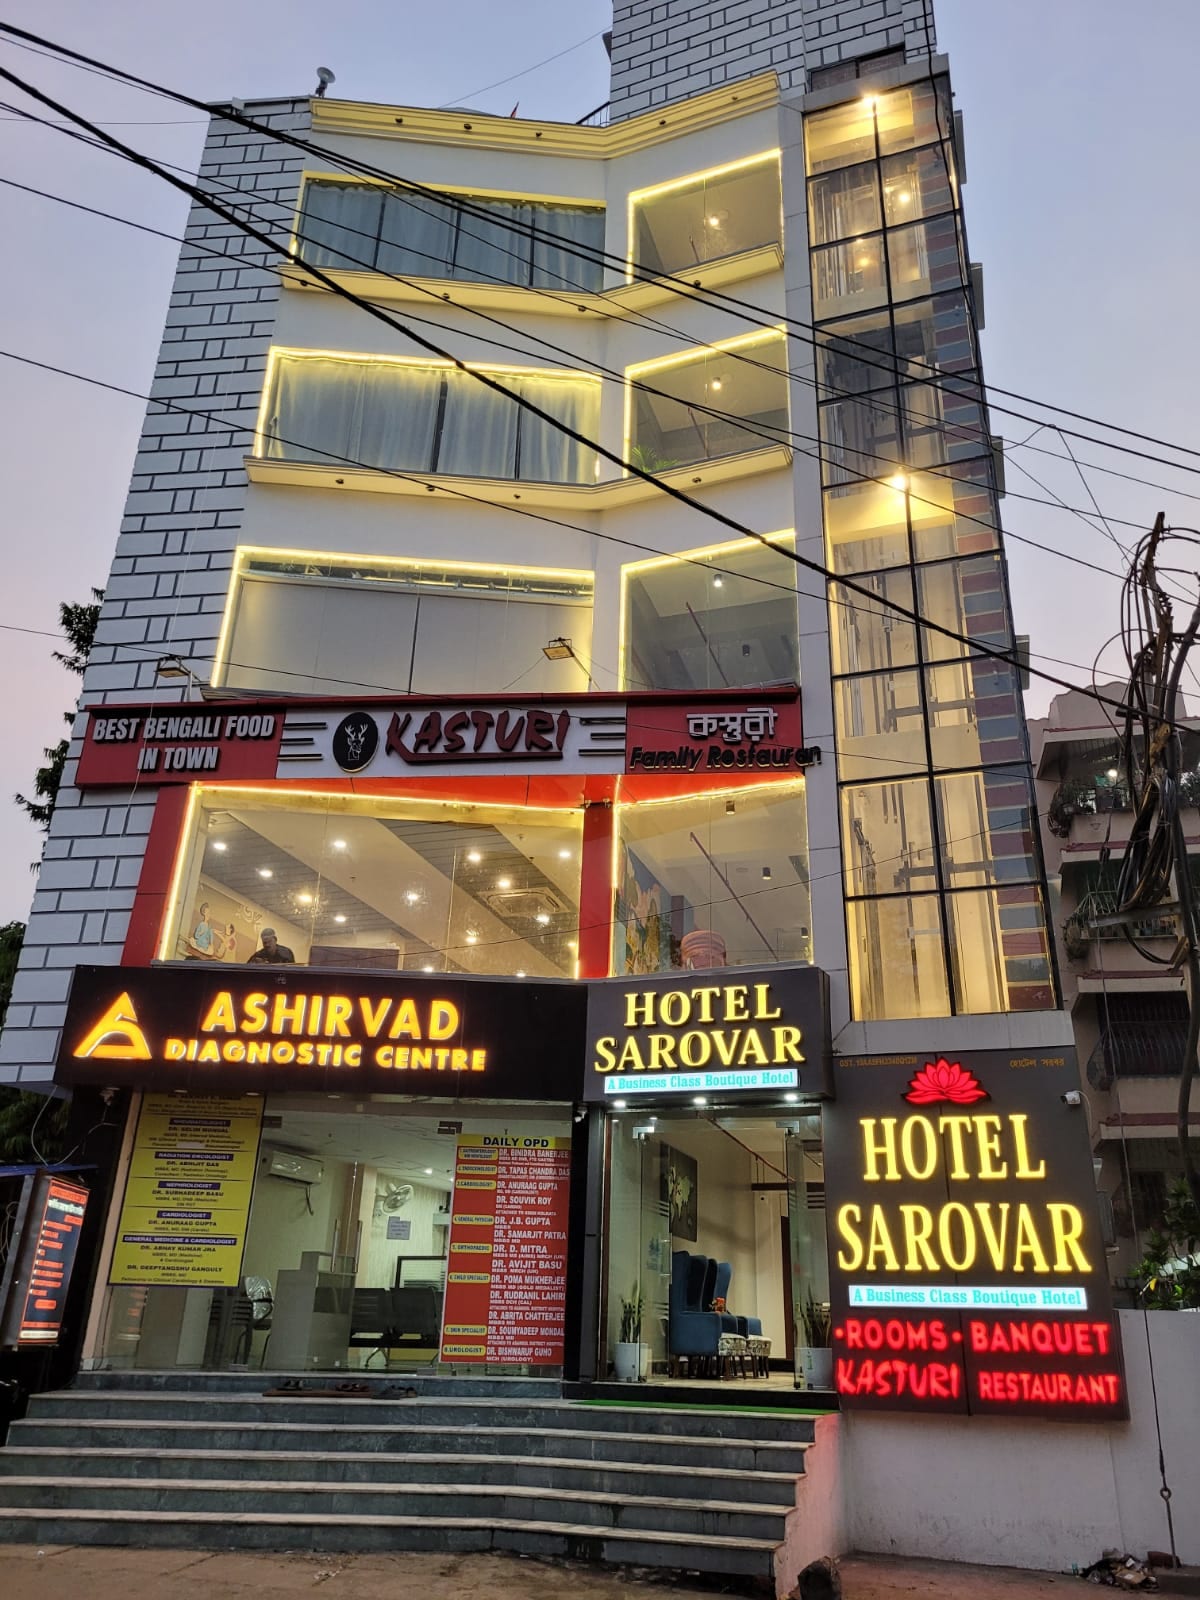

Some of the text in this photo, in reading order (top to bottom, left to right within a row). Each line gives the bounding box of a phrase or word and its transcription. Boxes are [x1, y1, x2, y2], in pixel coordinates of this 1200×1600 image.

[92, 716, 275, 741] BEST BENGALI FOOD
[385, 709, 570, 763] KASTURI
[137, 747, 219, 770] IN TOWN
[629, 746, 703, 771] Family
[623, 984, 781, 1027] HOTEL
[201, 991, 460, 1040] ASHIRVAD
[164, 1038, 487, 1071] DIAGNOSTIC CENTRE
[594, 1026, 805, 1072] SAROVAR
[608, 1072, 793, 1090] A Business Class Boutique Hotel
[483, 1137, 549, 1147] DAILY OPD
[860, 1114, 1046, 1181] HOTEL
[538, 1182, 558, 1190] GUPTA
[509, 1196, 536, 1204] SOUVIK
[537, 1197, 552, 1205] ROY
[495, 1216, 507, 1224] DR.
[525, 1217, 551, 1225] GUPTA
[494, 1230, 567, 1240] DR. SAMARJIT PATRA
[837, 1203, 1092, 1272] SAROVAR
[493, 1244, 507, 1252] DR.
[520, 1245, 548, 1254] MITRA
[492, 1260, 562, 1269] DR. AVIJIT BASU
[491, 1275, 503, 1283] DR.
[525, 1275, 566, 1284] MUKHERJEE
[490, 1291, 565, 1300] DR. RUDRANIL LAHIRI
[854, 1288, 1082, 1306] A Business Class Boutique Hotel
[489, 1311, 499, 1319] DR.
[525, 1312, 565, 1320] CHATTERJEE
[488, 1326, 498, 1334] DR.
[970, 1320, 1110, 1354] BANQUET
[487, 1347, 497, 1355] DR.
[835, 1357, 1119, 1404] KASTURI RESTAURANT
